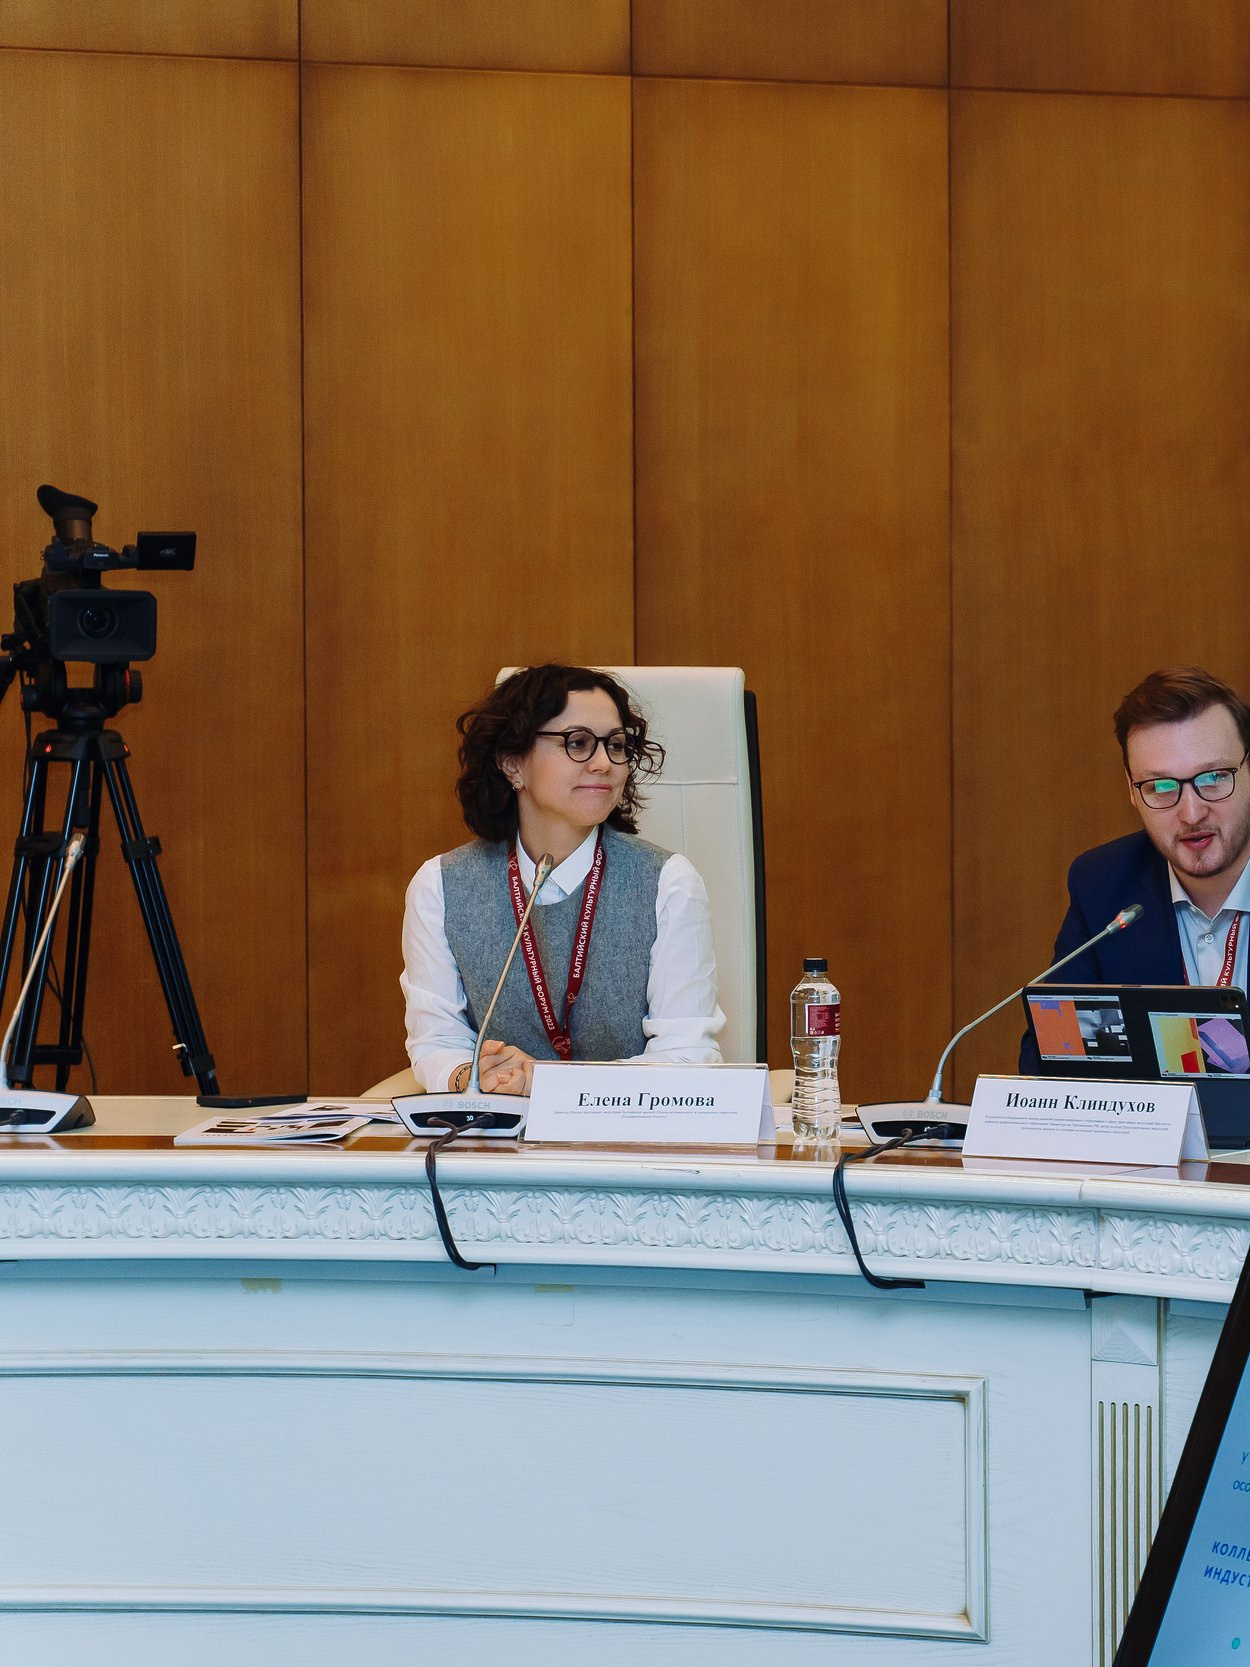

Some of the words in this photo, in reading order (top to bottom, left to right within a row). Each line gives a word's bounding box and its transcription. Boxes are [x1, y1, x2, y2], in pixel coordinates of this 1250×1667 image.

[572, 921, 589, 979] БАЛТИЙСКИЙ
[583, 867, 600, 921] КУЛЬТУРНЫЙ
[522, 931, 542, 984] КУЛЬТУРНЫЙ
[536, 984, 549, 1014] ФОРУМ
[544, 1014, 555, 1031] 2023
[457, 1101, 491, 1110] BOSCH
[578, 1092, 631, 1107] Елена
[637, 1092, 715, 1110] Громова
[1005, 1092, 1058, 1110] Иоанн
[1062, 1095, 1156, 1116] Клиндухов
[917, 1110, 948, 1120] BOSCH
[1241, 1451, 1249, 1465] у
